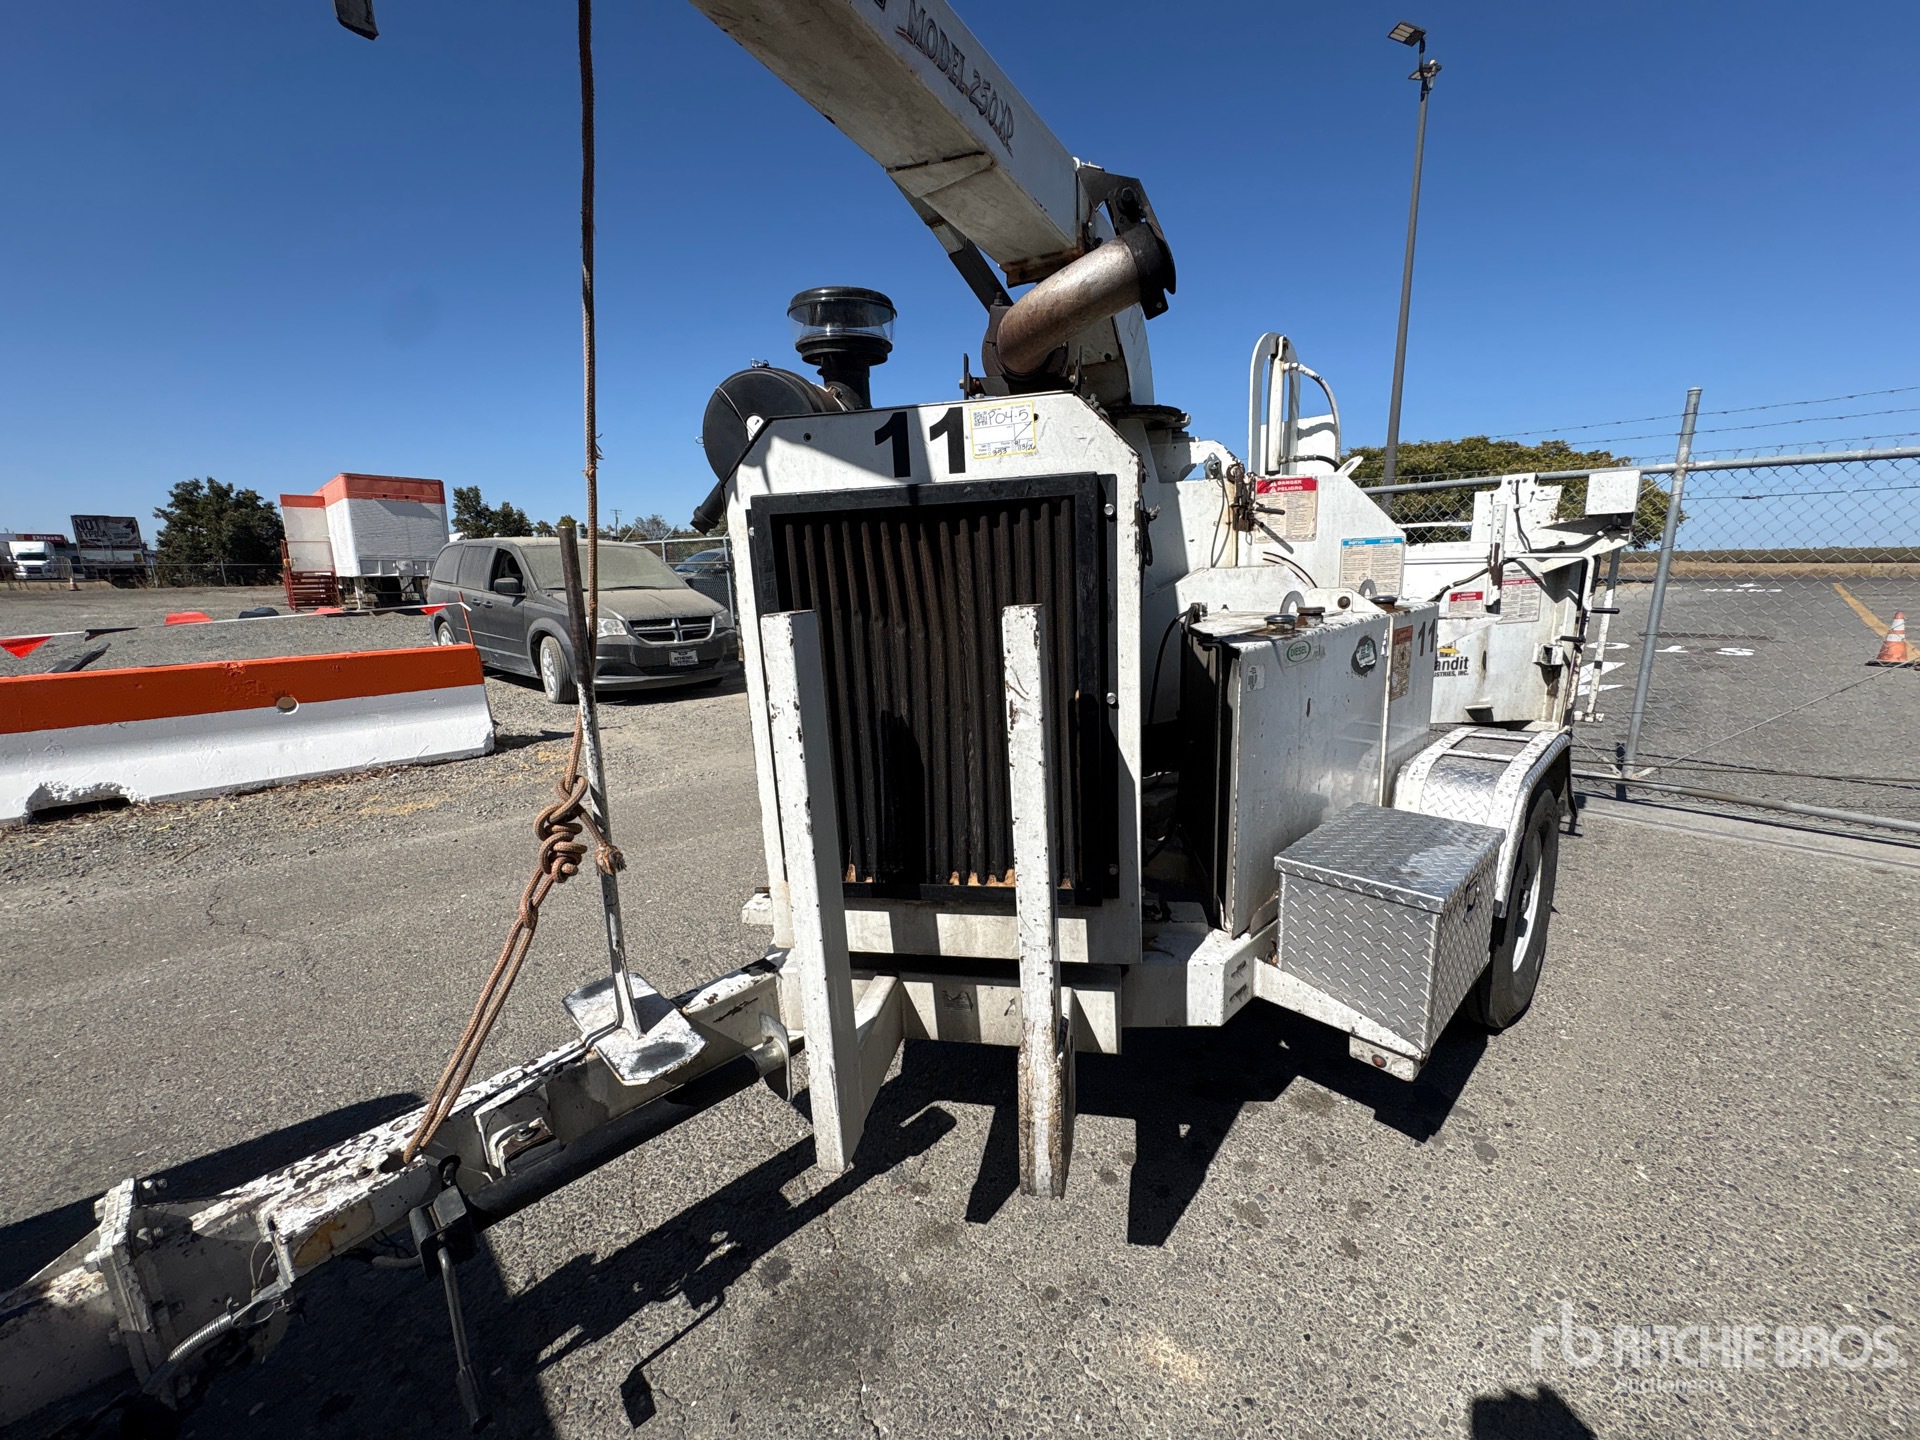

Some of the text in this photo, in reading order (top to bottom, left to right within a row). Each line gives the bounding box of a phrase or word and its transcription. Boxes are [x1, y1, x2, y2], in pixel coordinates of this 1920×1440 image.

[897, 0, 968, 94] MODEL
[874, 407, 966, 478] 11
[1418, 618, 1435, 656] 11
[1586, 642, 1756, 656] STO
[1290, 646, 1308, 657] DIESEL
[1434, 656, 1469, 671] andit
